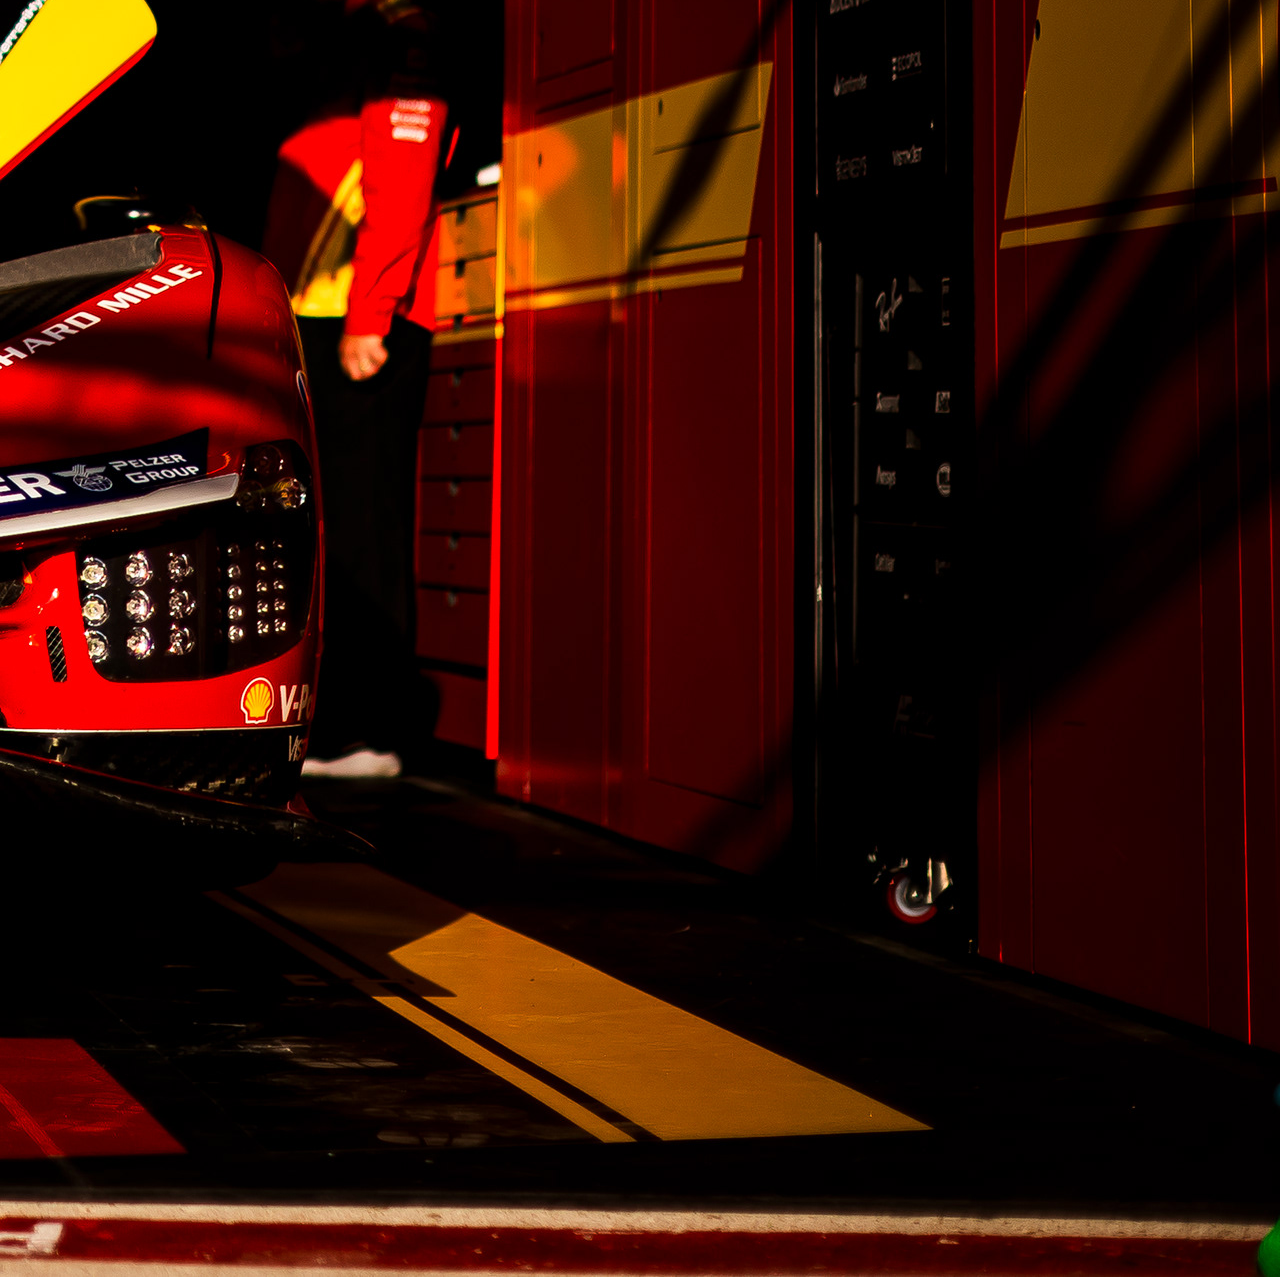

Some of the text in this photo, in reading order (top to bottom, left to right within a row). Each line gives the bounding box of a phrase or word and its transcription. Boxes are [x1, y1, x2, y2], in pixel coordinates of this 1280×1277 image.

[97, 264, 202, 313] MILLE
[108, 453, 186, 471] PELZER
[124, 465, 200, 484] GROUP
